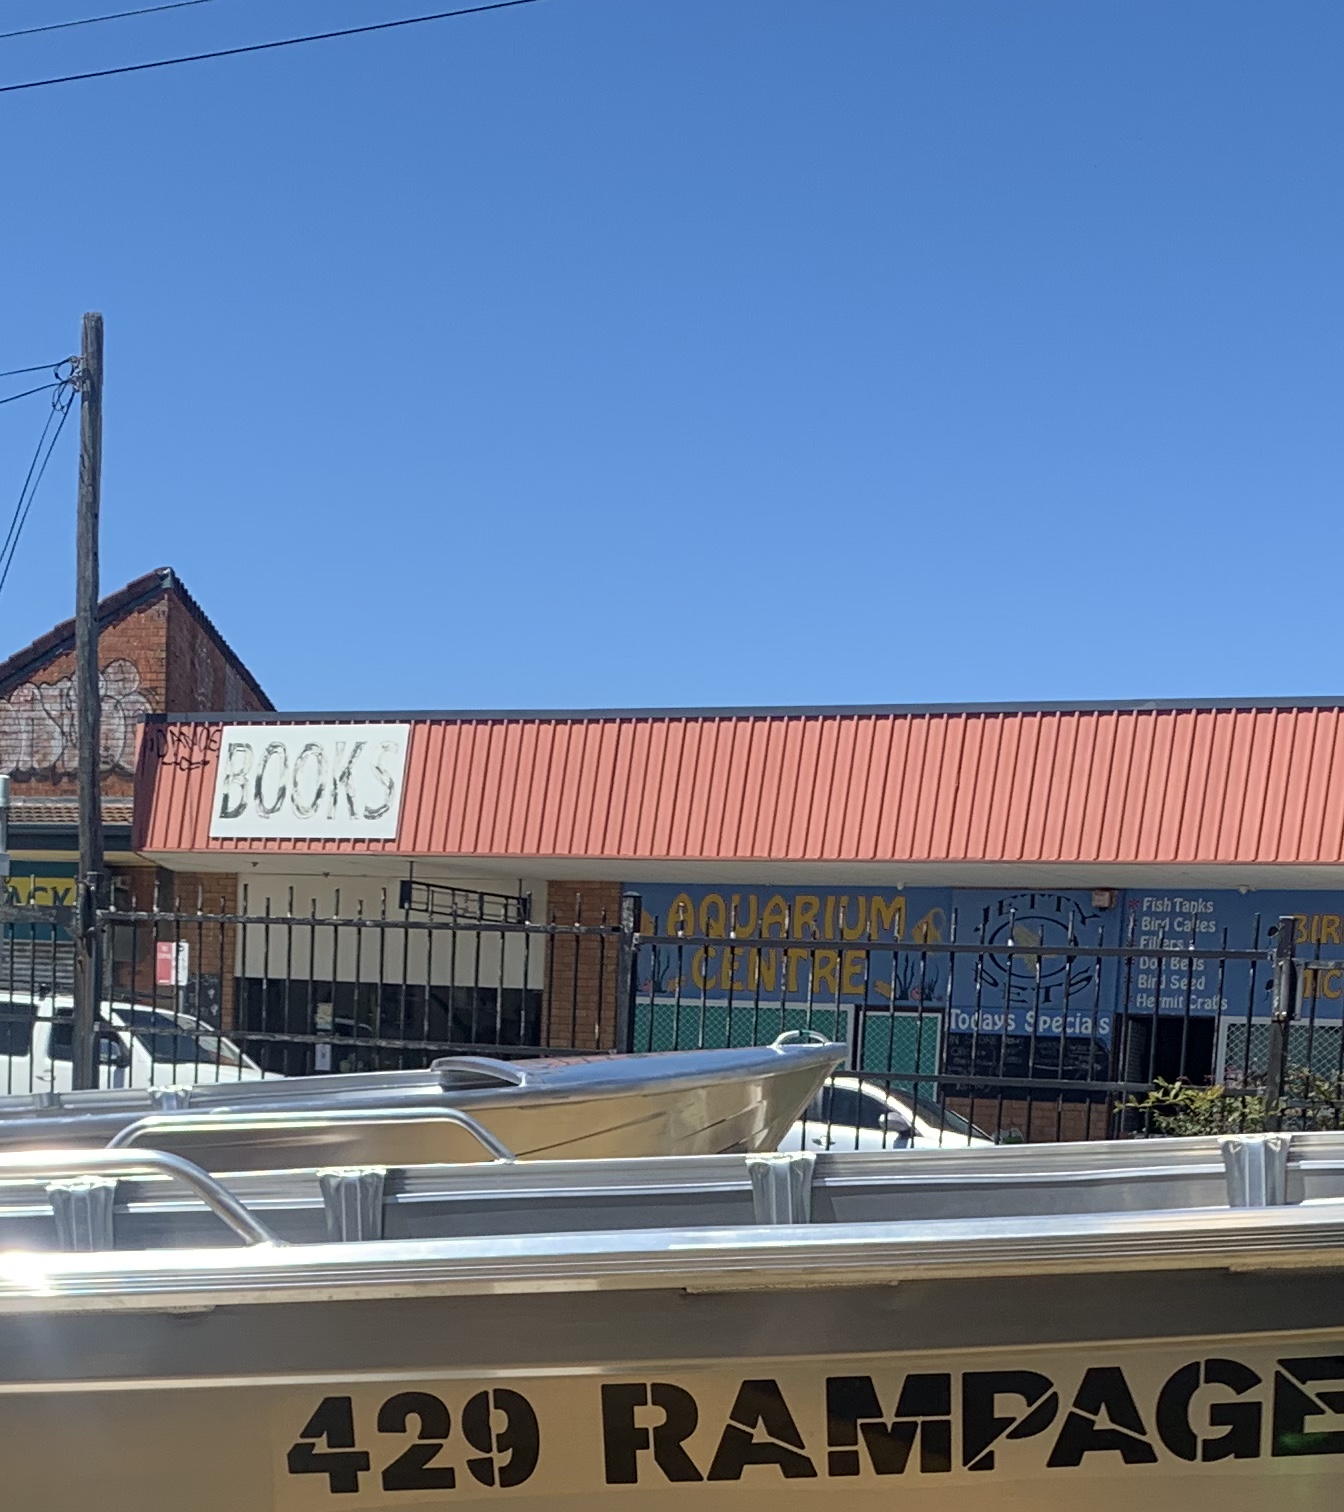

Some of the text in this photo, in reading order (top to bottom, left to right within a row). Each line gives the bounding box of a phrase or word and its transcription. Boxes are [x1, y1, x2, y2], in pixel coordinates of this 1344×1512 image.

[219, 740, 398, 820] BOOKS
[666, 892, 906, 941] AQUARIUM
[1142, 897, 1214, 914] Fish Tanks
[691, 945, 866, 995] CENTRE
[1170, 975, 1206, 990] Seed
[950, 1008, 1110, 1034] Todays Specias
[287, 1388, 540, 1494] 429
